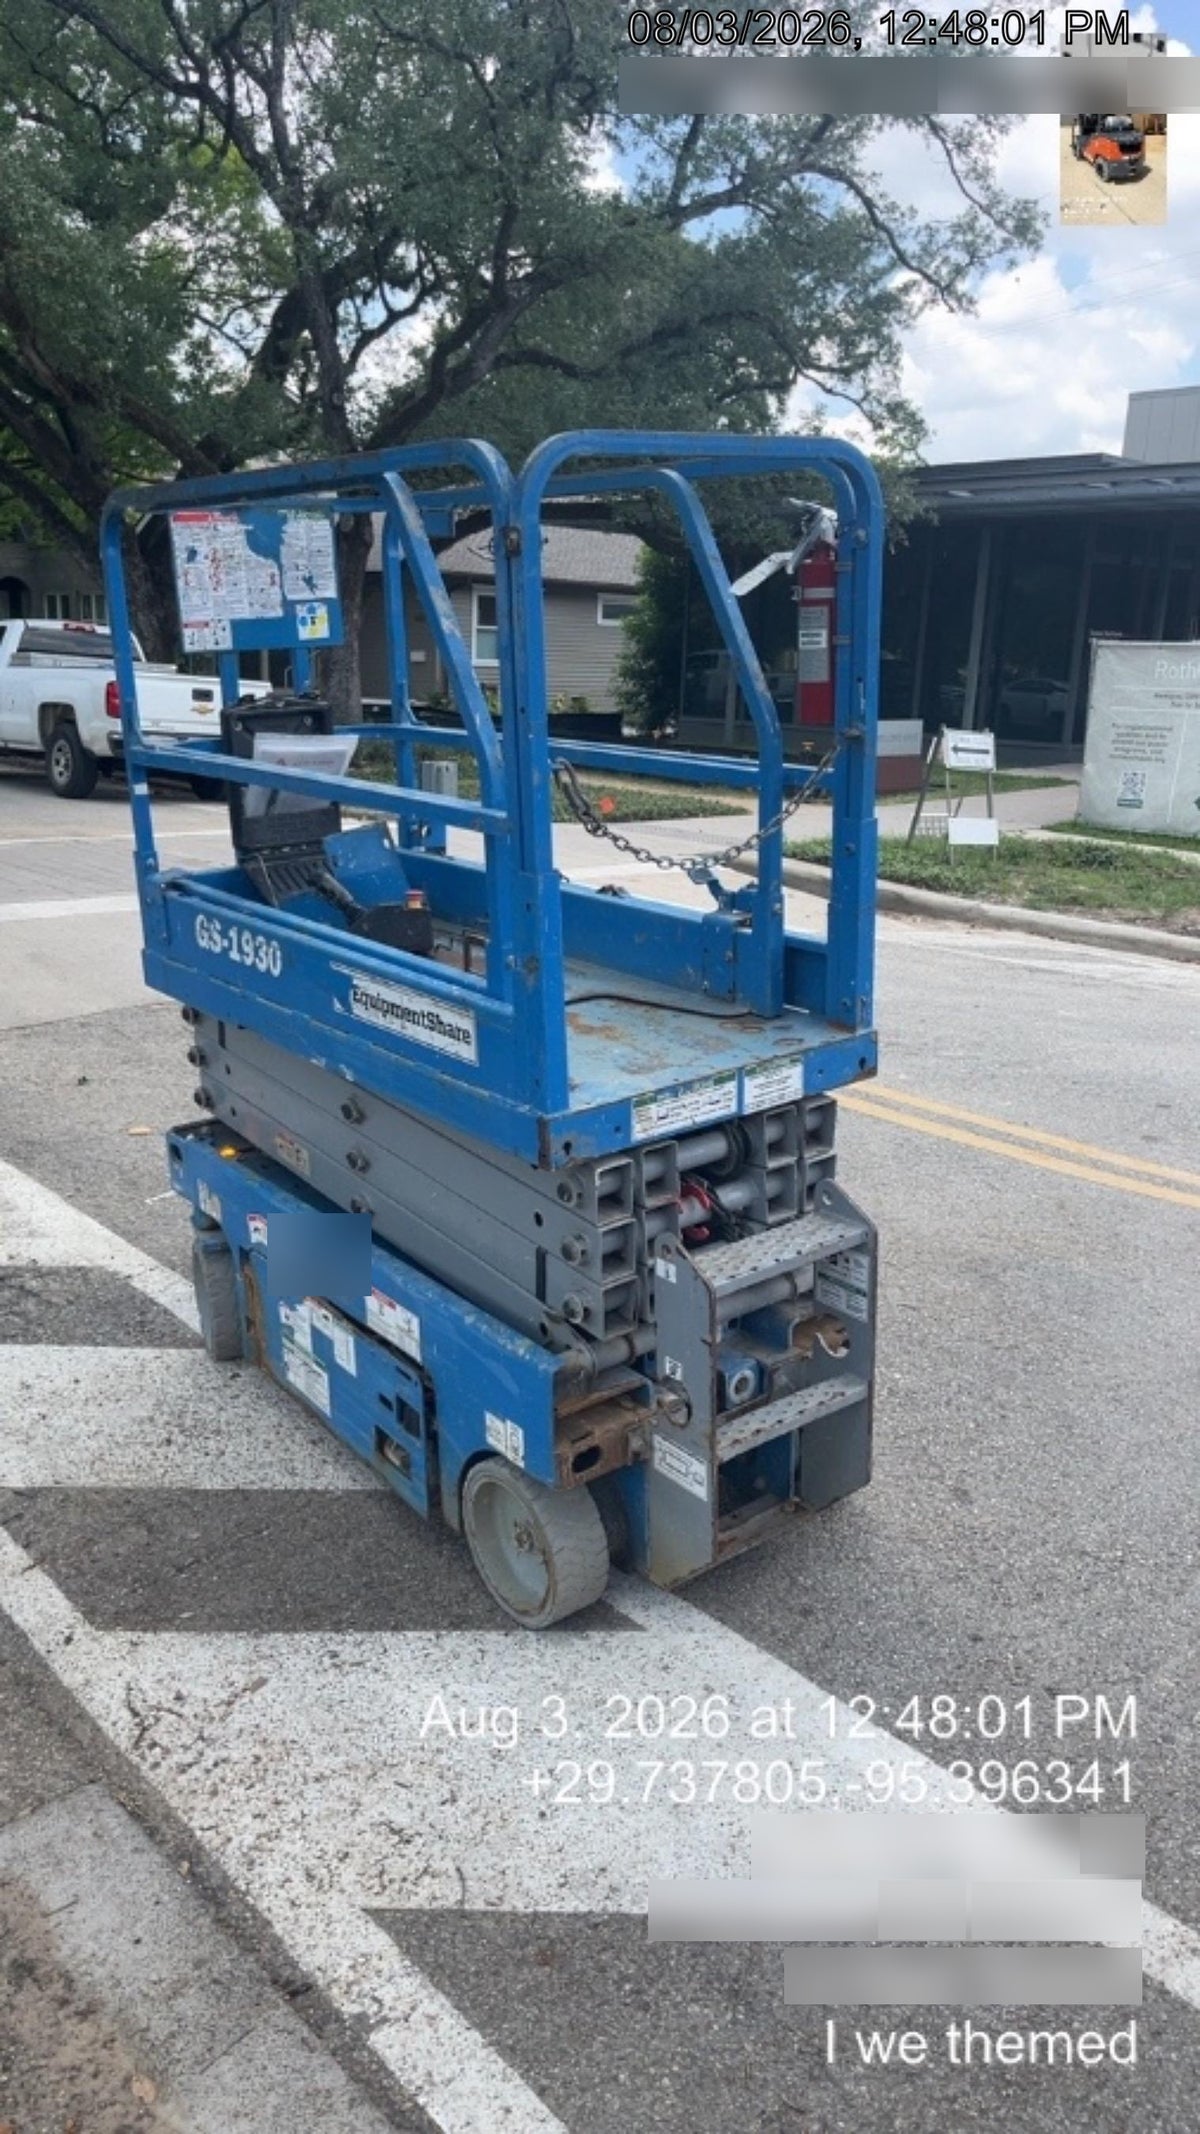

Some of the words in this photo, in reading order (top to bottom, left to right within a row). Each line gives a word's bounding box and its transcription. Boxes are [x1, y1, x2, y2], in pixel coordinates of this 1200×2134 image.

[1154, 659, 1200, 680] Roth
[195, 914, 282, 977] GS-1930
[353, 988, 472, 1046] EquipmentShare
